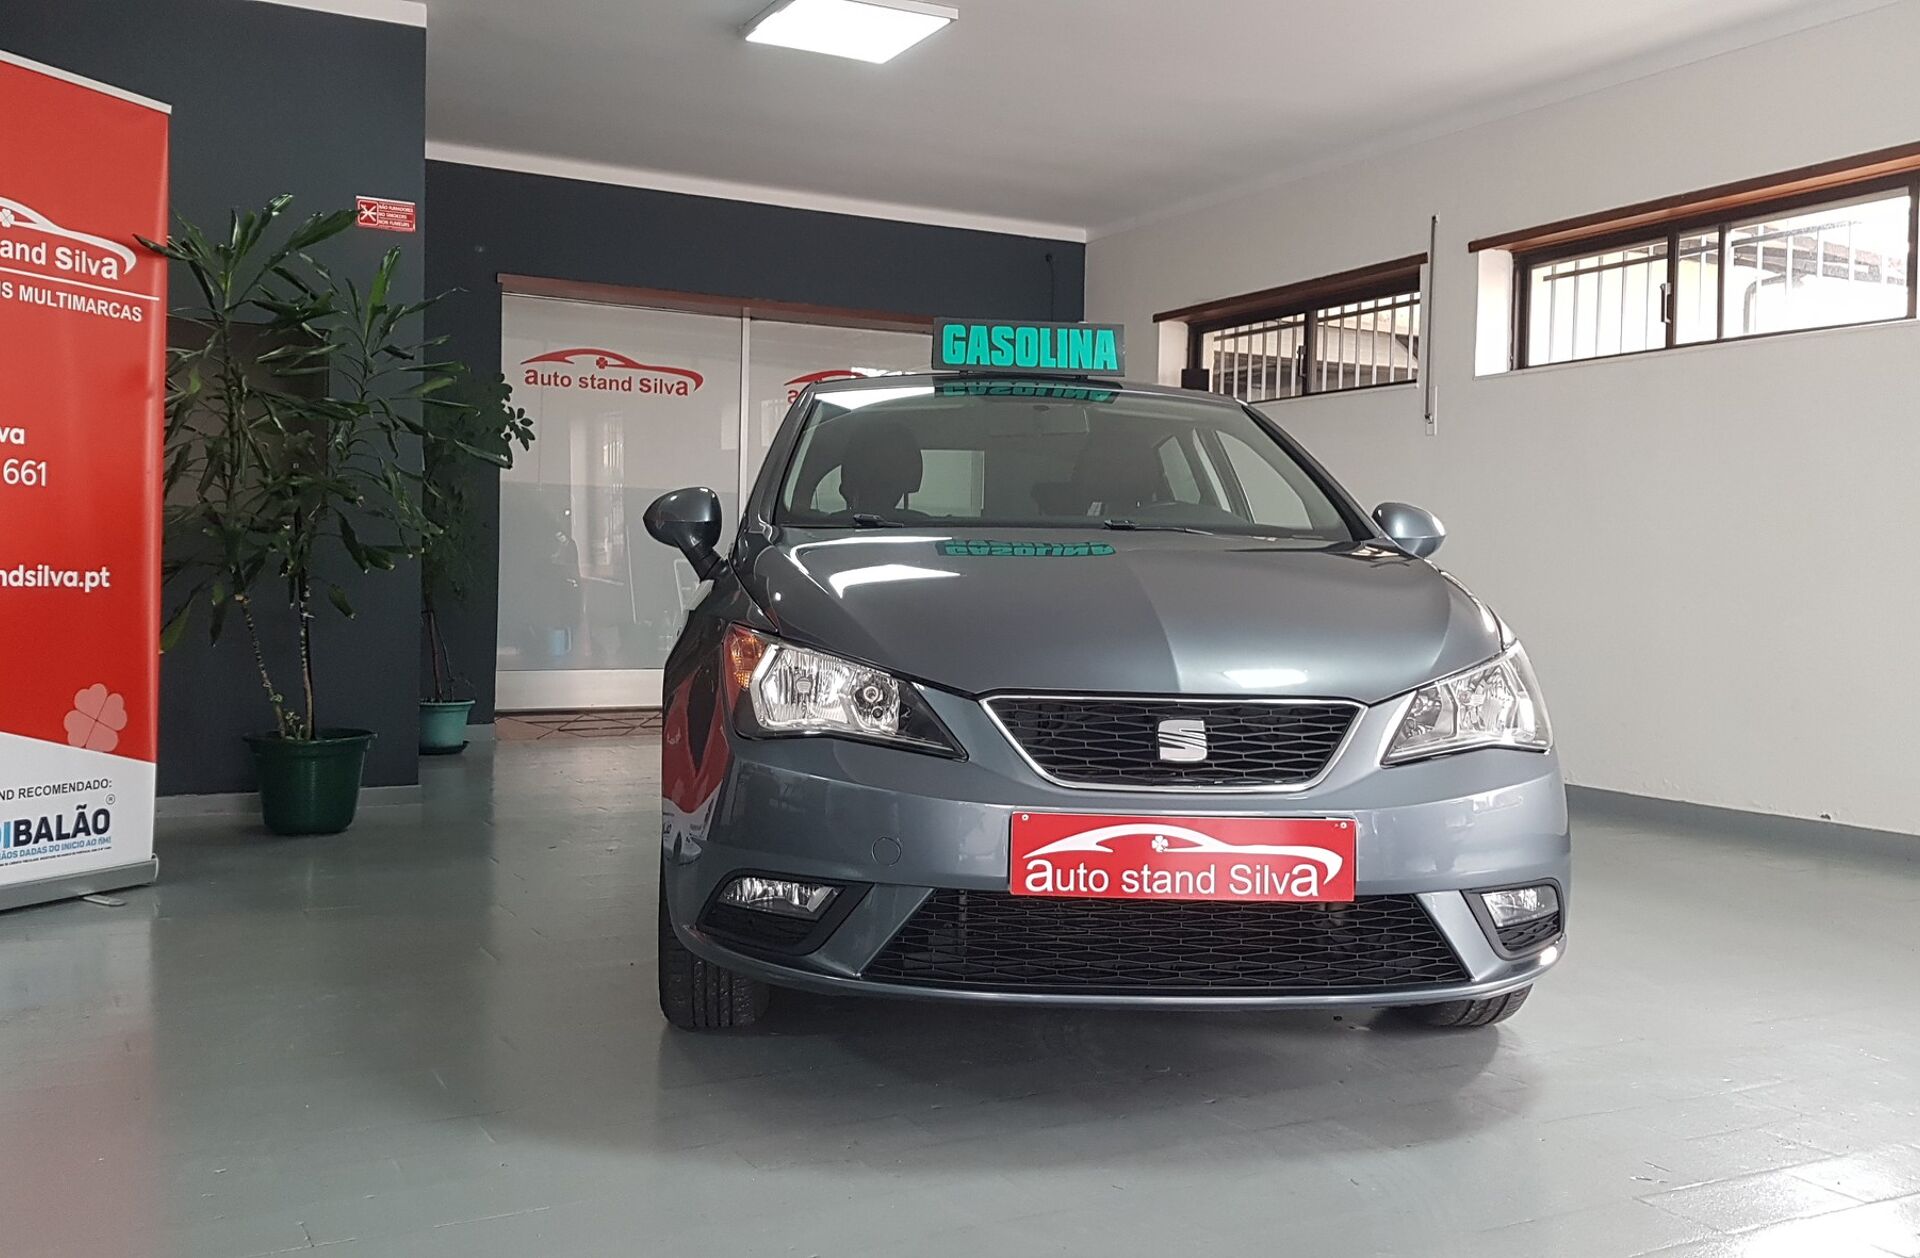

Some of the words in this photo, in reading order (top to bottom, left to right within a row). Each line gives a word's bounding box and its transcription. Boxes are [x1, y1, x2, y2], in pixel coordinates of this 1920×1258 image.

[55, 246, 118, 280] Silva
[19, 284, 142, 322] MULTIMARCAS
[943, 324, 1118, 370] GASOLINA
[525, 369, 572, 388] auto
[578, 374, 632, 392] stand
[639, 377, 688, 396] Silva
[3, 458, 48, 487] 661
[18, 778, 112, 799] RECOMENDADO:
[19, 846, 47, 857] DADAS
[48, 844, 60, 853] DO
[86, 838, 97, 847] AO
[1024, 858, 1109, 894] auto
[1121, 863, 1216, 895] stand
[1228, 863, 1319, 897] Silva
